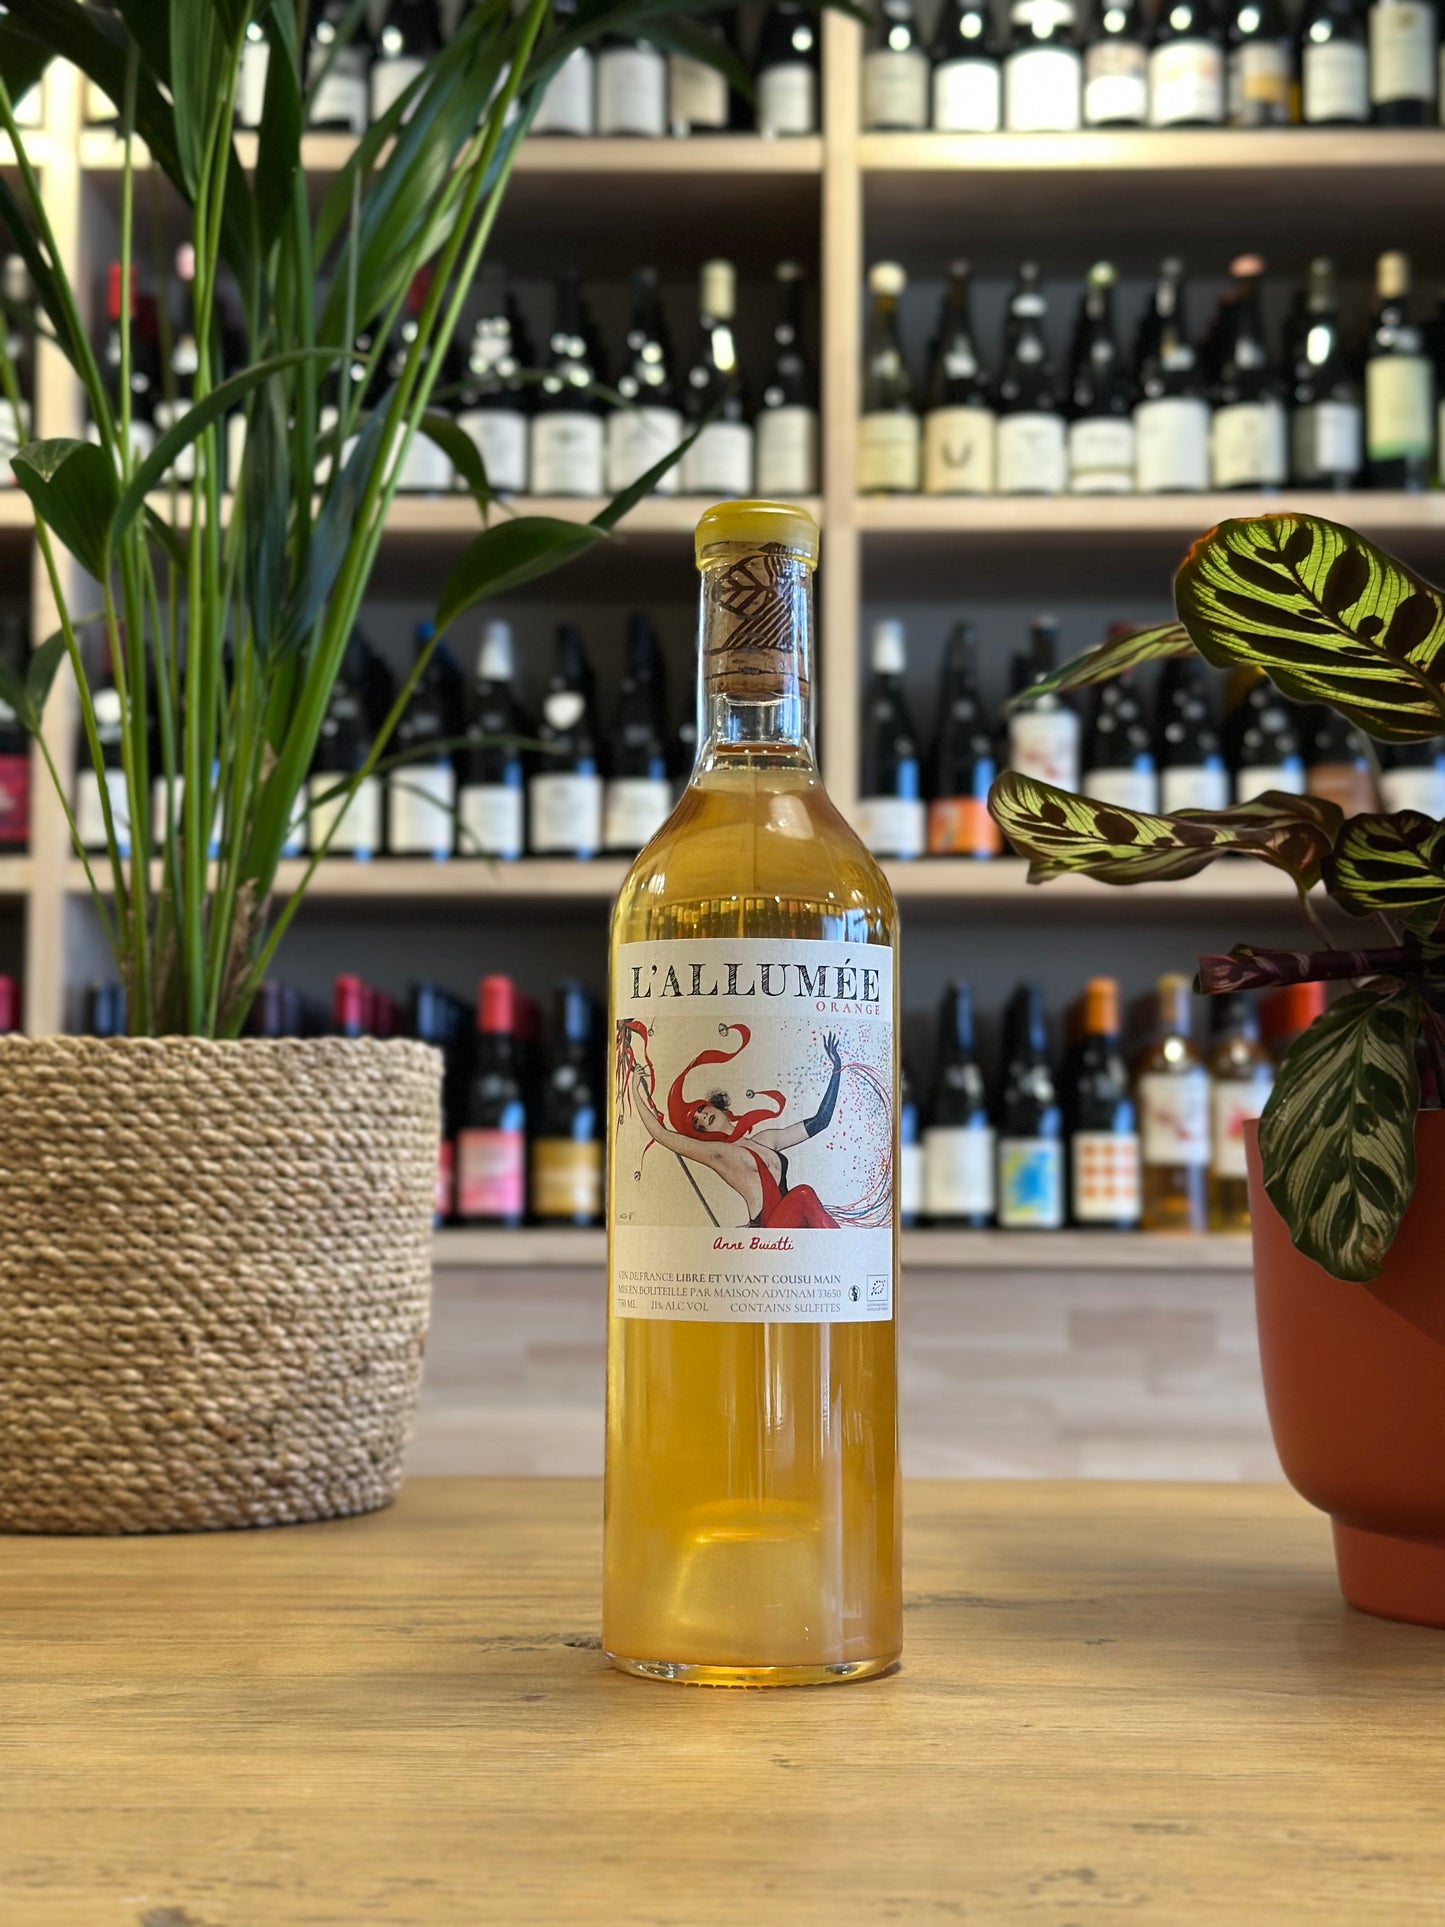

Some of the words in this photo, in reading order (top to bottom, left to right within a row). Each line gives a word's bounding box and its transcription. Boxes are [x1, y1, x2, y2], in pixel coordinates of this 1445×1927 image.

[631, 958, 880, 1002] L'ALLUMÉE
[816, 1001, 881, 1016] ORANGE
[713, 1236, 745, 1250] Anne
[749, 1236, 795, 1251] Buiatti
[618, 1271, 628, 1281] VIN
[629, 1271, 638, 1281] DE
[639, 1271, 674, 1282] FRANCE
[676, 1273, 706, 1283] LIBRE
[708, 1274, 722, 1284] ET
[725, 1274, 769, 1284] VIVANT
[772, 1274, 812, 1284] COUSU
[814, 1274, 841, 1284] MAIN
[618, 1285, 628, 1295] MIS
[629, 1286, 638, 1295] EN
[639, 1286, 688, 1297] BOUTEILLE
[690, 1287, 711, 1298] PAR
[714, 1288, 759, 1299] MAISON
[762, 1288, 815, 1299] ADVINAM
[818, 1288, 842, 1299] 33650
[618, 1298, 626, 1308] 750
[627, 1299, 637, 1309] ML
[686, 1302, 710, 1312] VOL
[730, 1302, 791, 1313] CONTAINS
[794, 1302, 841, 1313] SULFITES
